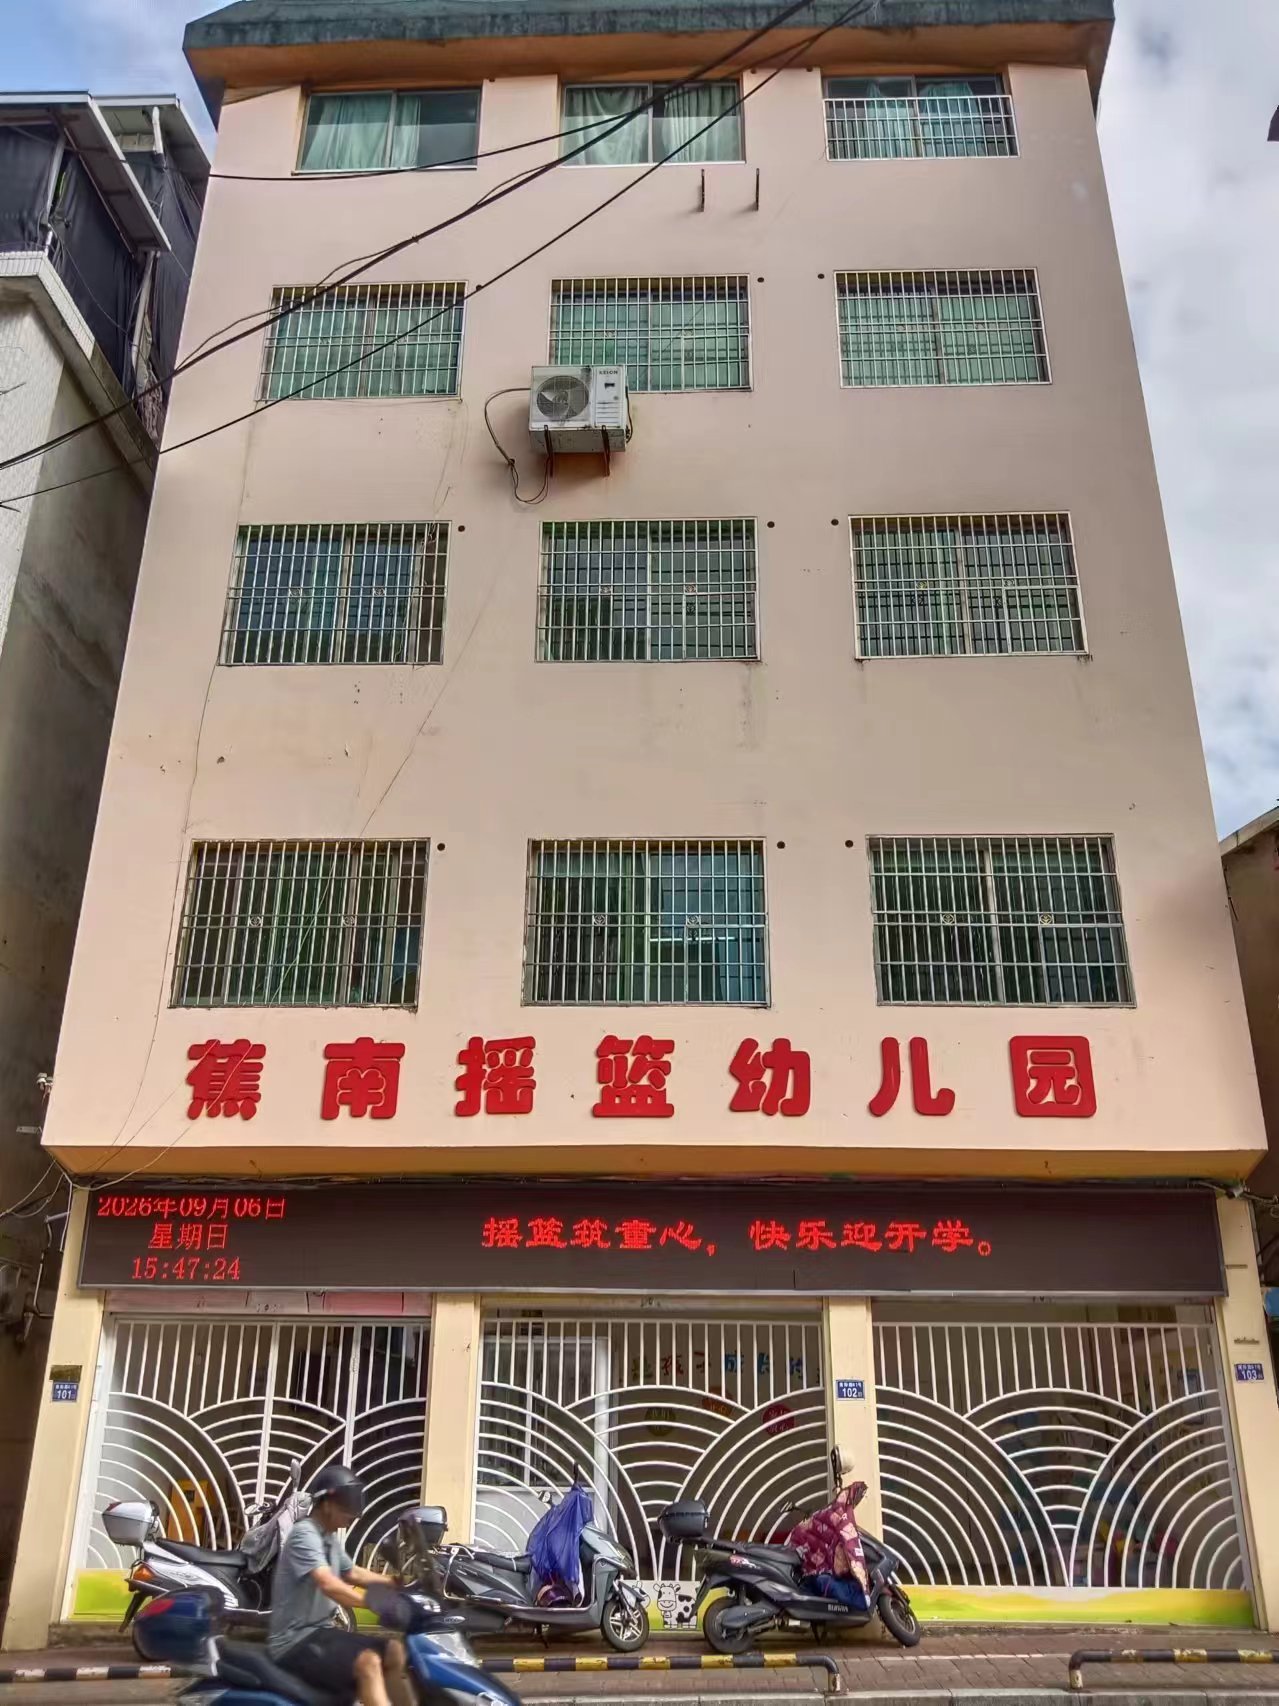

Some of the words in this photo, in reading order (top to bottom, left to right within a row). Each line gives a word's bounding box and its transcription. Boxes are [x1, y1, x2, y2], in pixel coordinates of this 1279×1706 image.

[187, 1036, 1097, 1120] 蕉南摇篮幼儿园
[98, 1197, 286, 1220] 2026年09月06日
[148, 1223, 228, 1250] 星期日
[132, 1256, 241, 1280] 15:47:24
